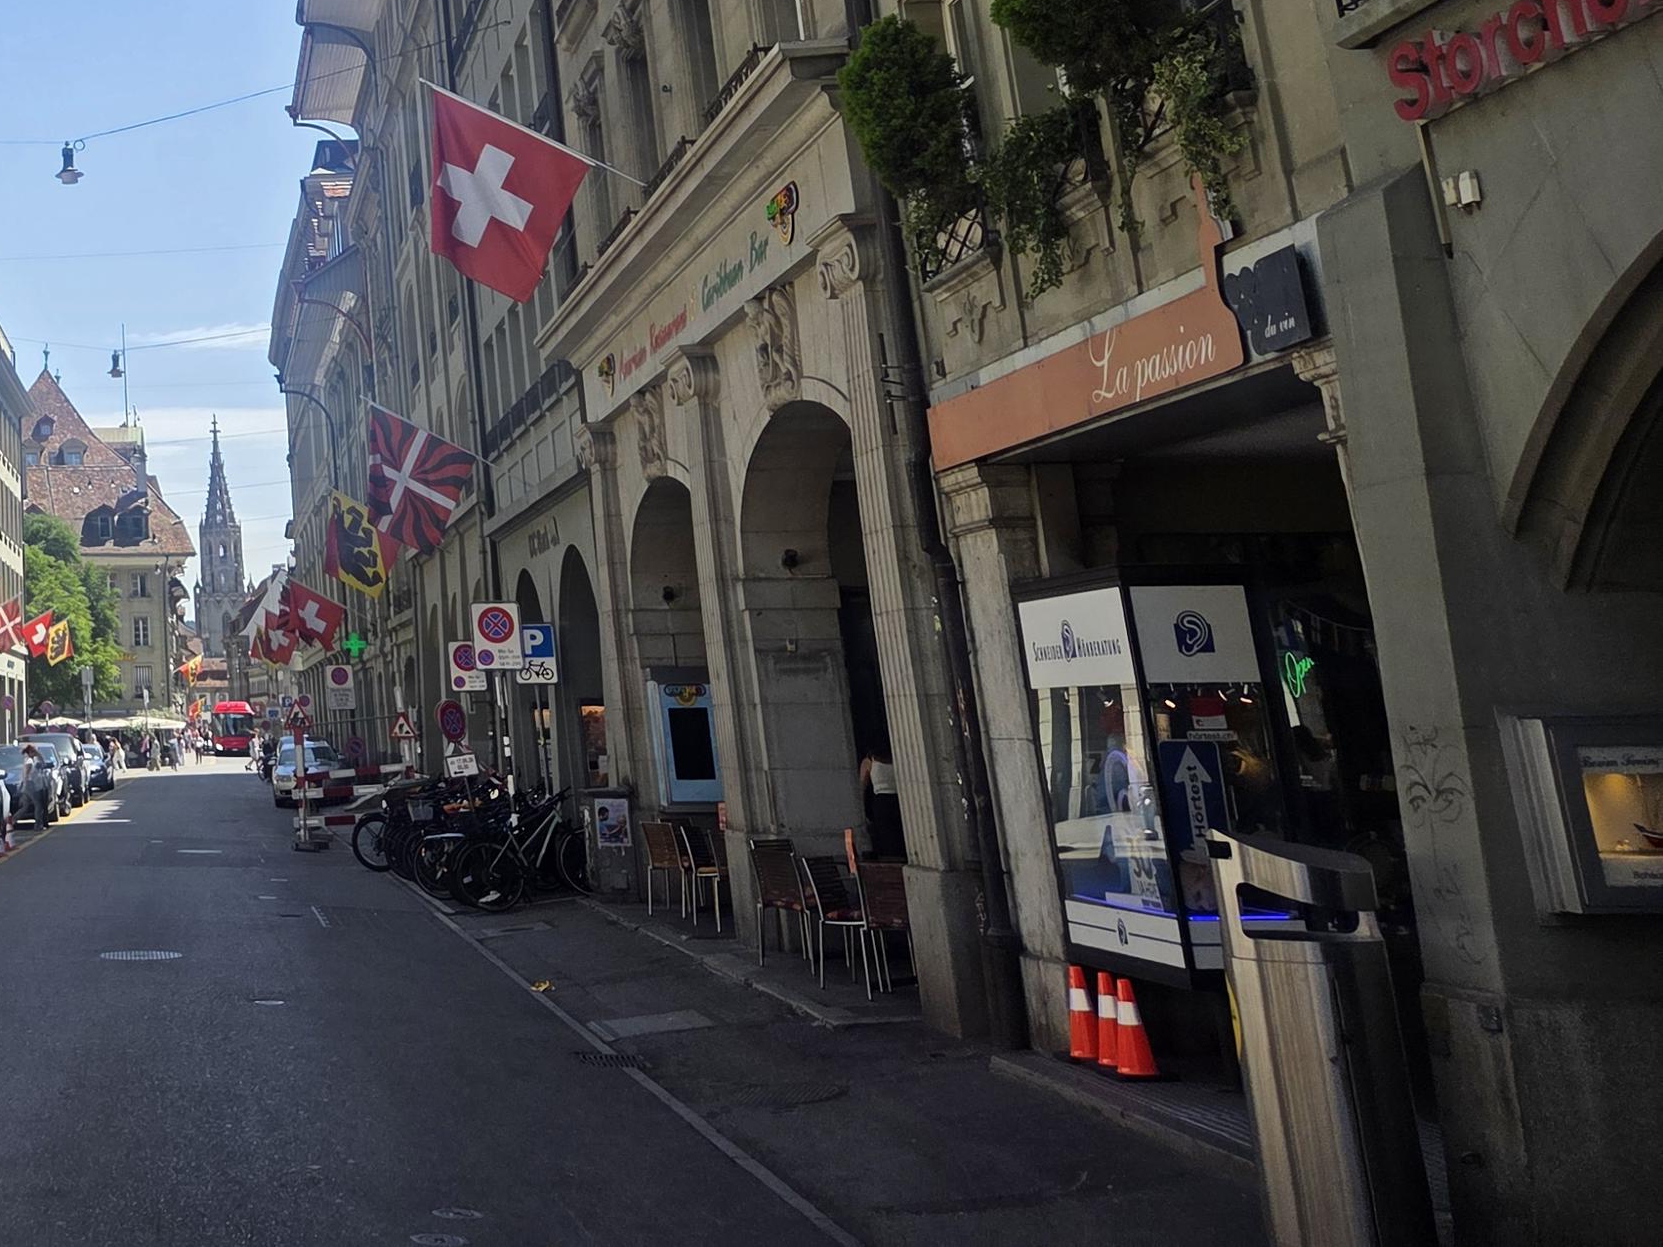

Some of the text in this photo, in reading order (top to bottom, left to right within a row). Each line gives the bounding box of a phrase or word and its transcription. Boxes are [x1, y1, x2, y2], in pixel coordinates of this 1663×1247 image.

[748, 230, 770, 274] Bar
[1264, 312, 1296, 339] du vin
[1090, 325, 1216, 403] La passion
[525, 629, 545, 656] P
[1284, 651, 1315, 698] Open
[1187, 763, 1207, 840] Hörtest
